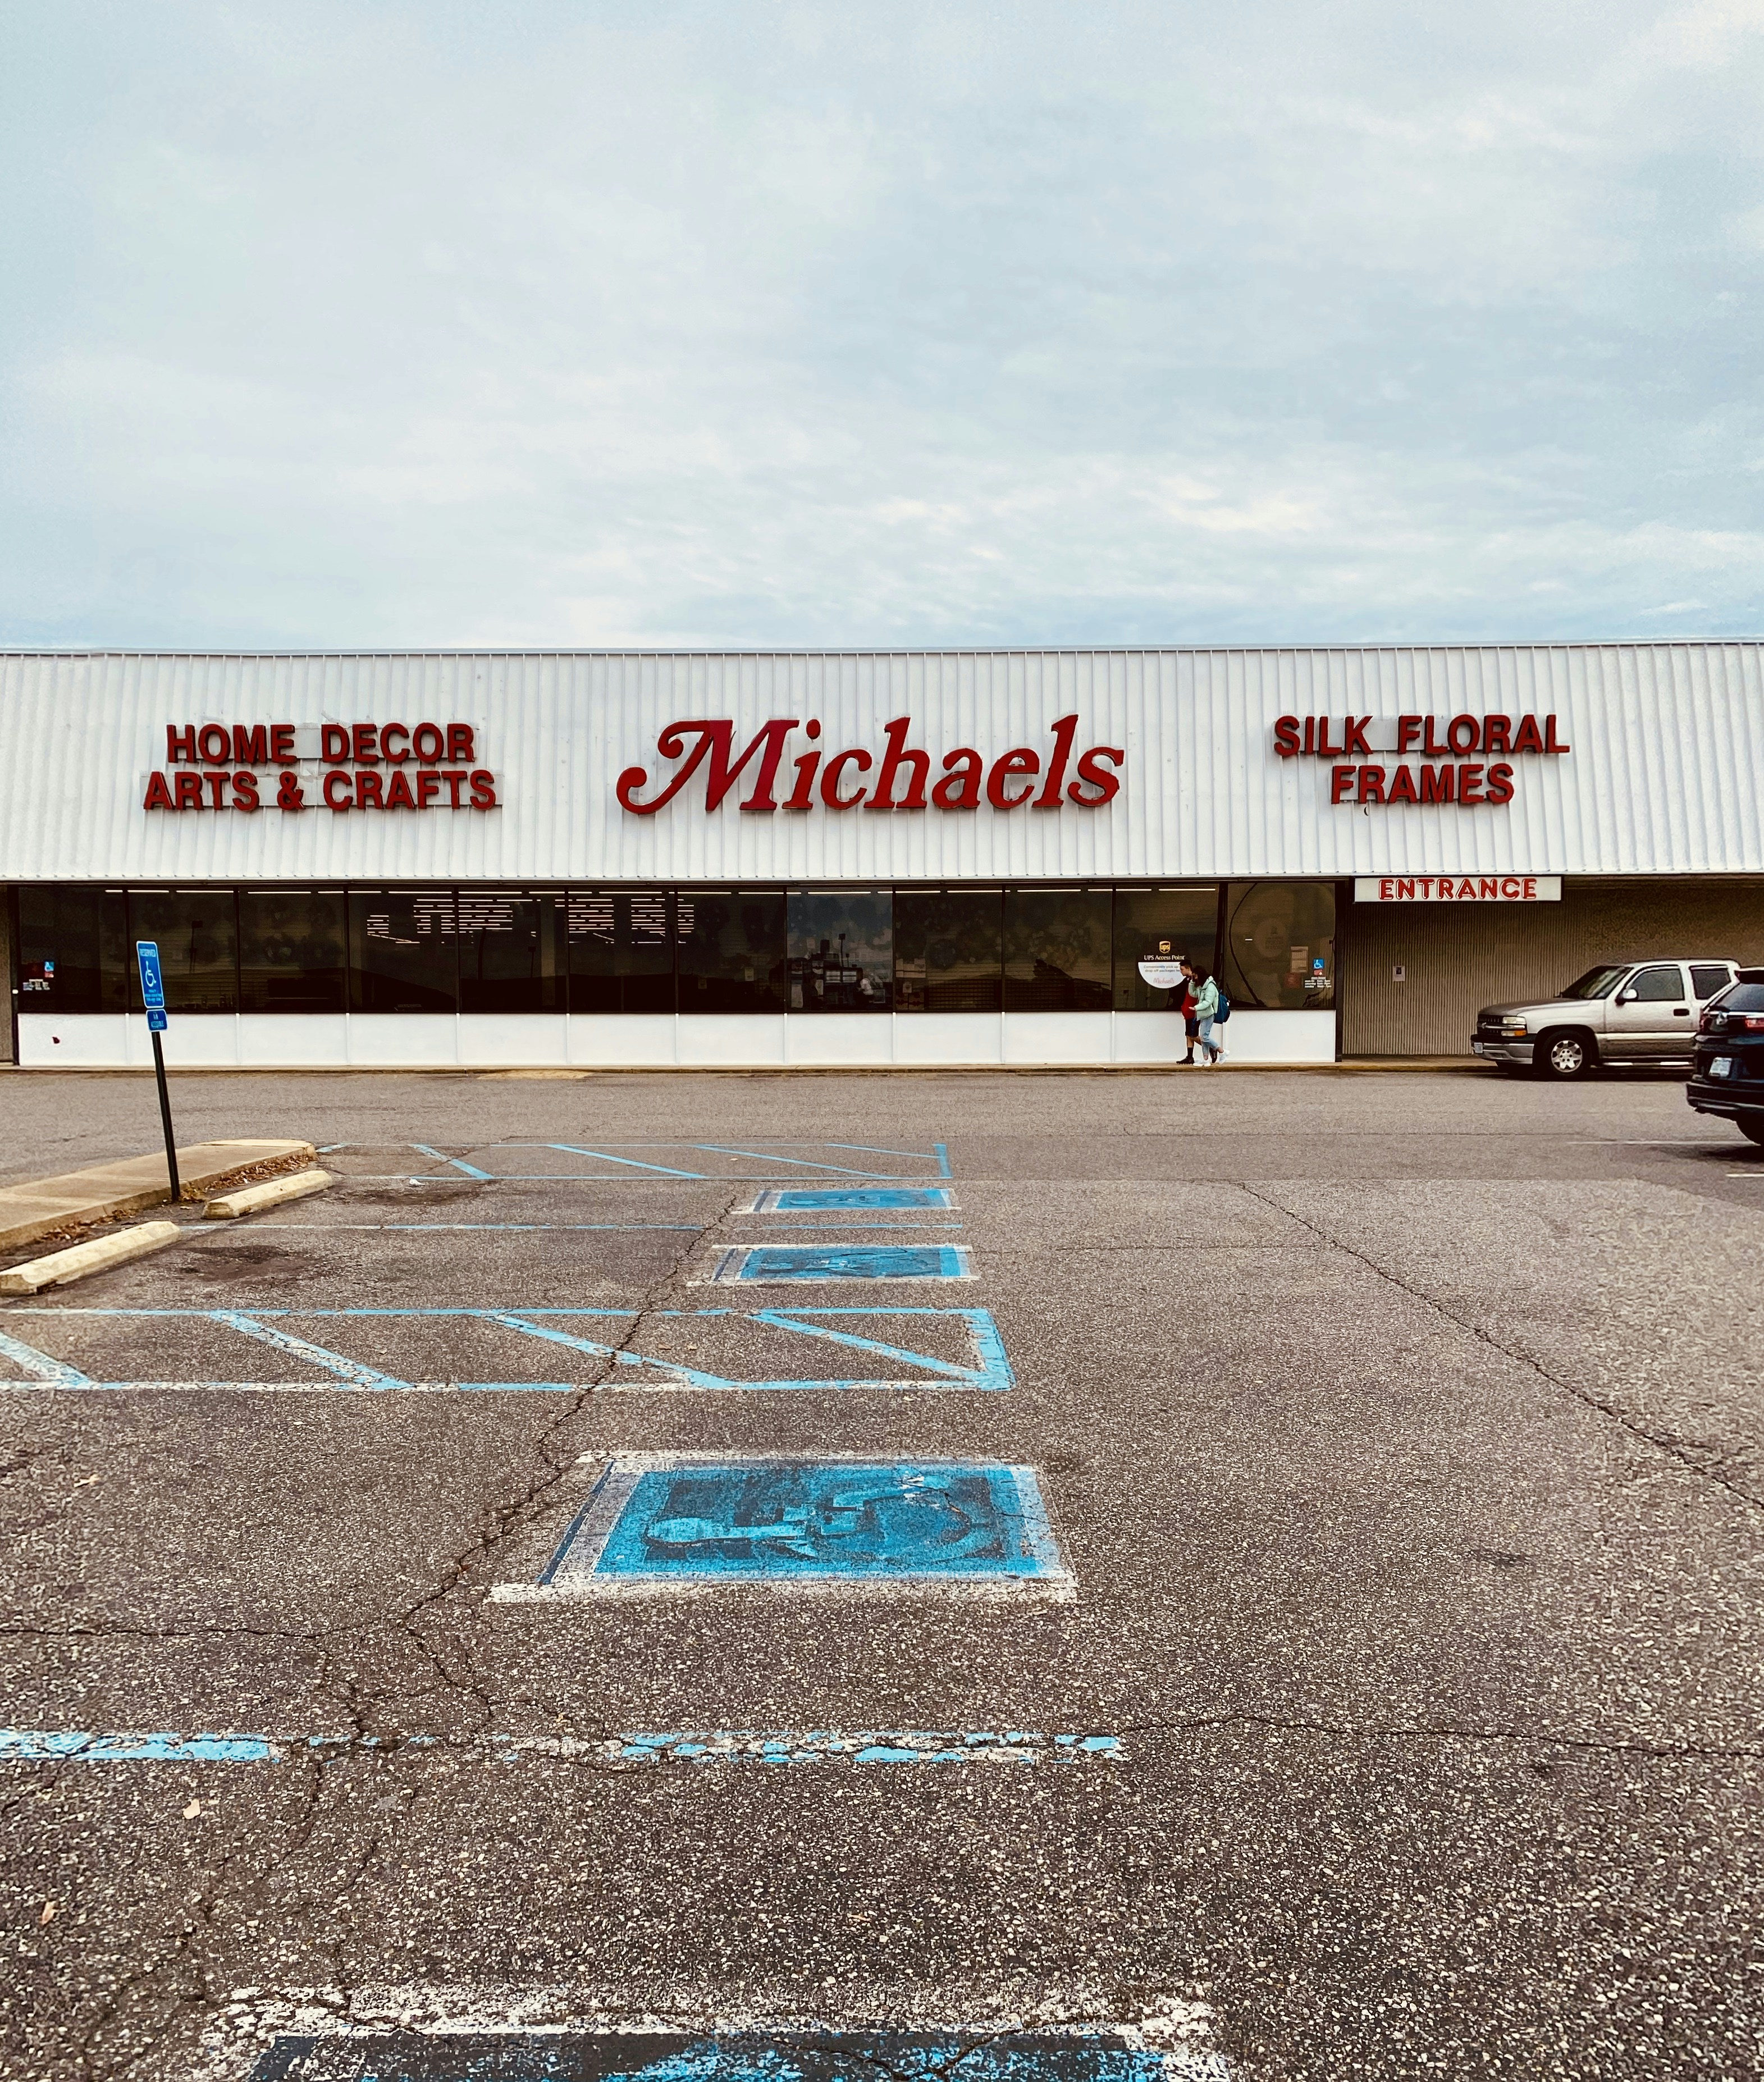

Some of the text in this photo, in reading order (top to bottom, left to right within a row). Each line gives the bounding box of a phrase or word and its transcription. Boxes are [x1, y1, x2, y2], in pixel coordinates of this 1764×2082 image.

[166, 722, 475, 765] HOME DECOR
[1274, 714, 1570, 757] SILK FLORAL
[616, 714, 1125, 816] Michaels
[1331, 763, 1515, 805] FRAMES
[143, 769, 497, 812] ARTS & CRAFTS
[1378, 877, 1537, 900] ENTRANCE
